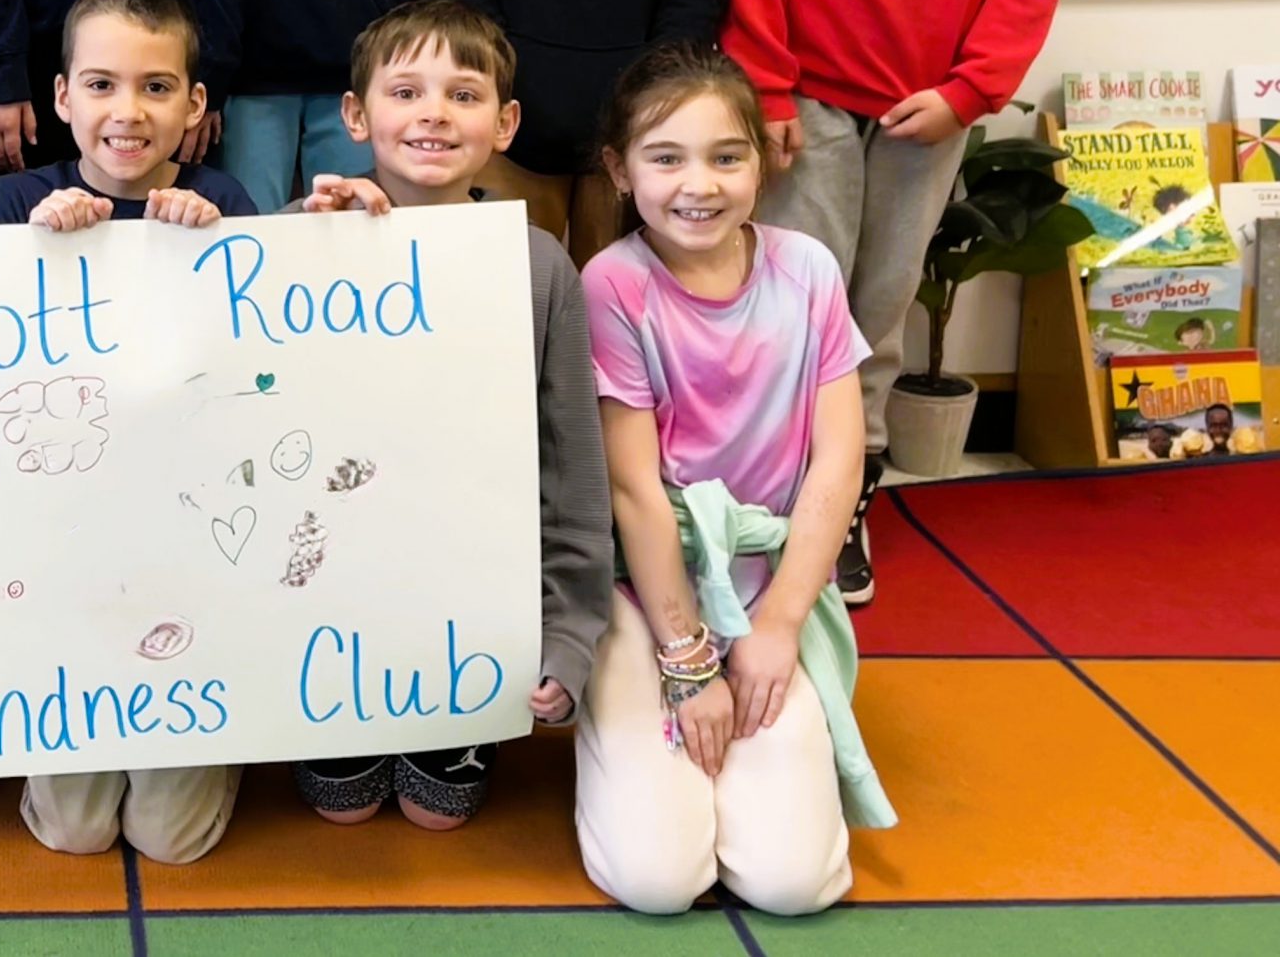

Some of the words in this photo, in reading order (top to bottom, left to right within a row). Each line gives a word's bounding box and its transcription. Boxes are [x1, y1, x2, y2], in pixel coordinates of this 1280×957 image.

[1068, 80, 1093, 100] THE
[1099, 79, 1144, 99] SMART
[1149, 78, 1201, 98] COOKIE
[1064, 133, 1132, 156] STAND
[1116, 157, 1143, 171] LOU
[1146, 155, 1195, 170] MELON
[193, 233, 434, 344] Road
[1111, 279, 1210, 308] Everybody
[1123, 282, 1151, 292] What
[1161, 299, 1179, 309] Did
[1182, 297, 1211, 307] That?
[1137, 376, 1232, 420] GHANA
[299, 619, 505, 724] Club
